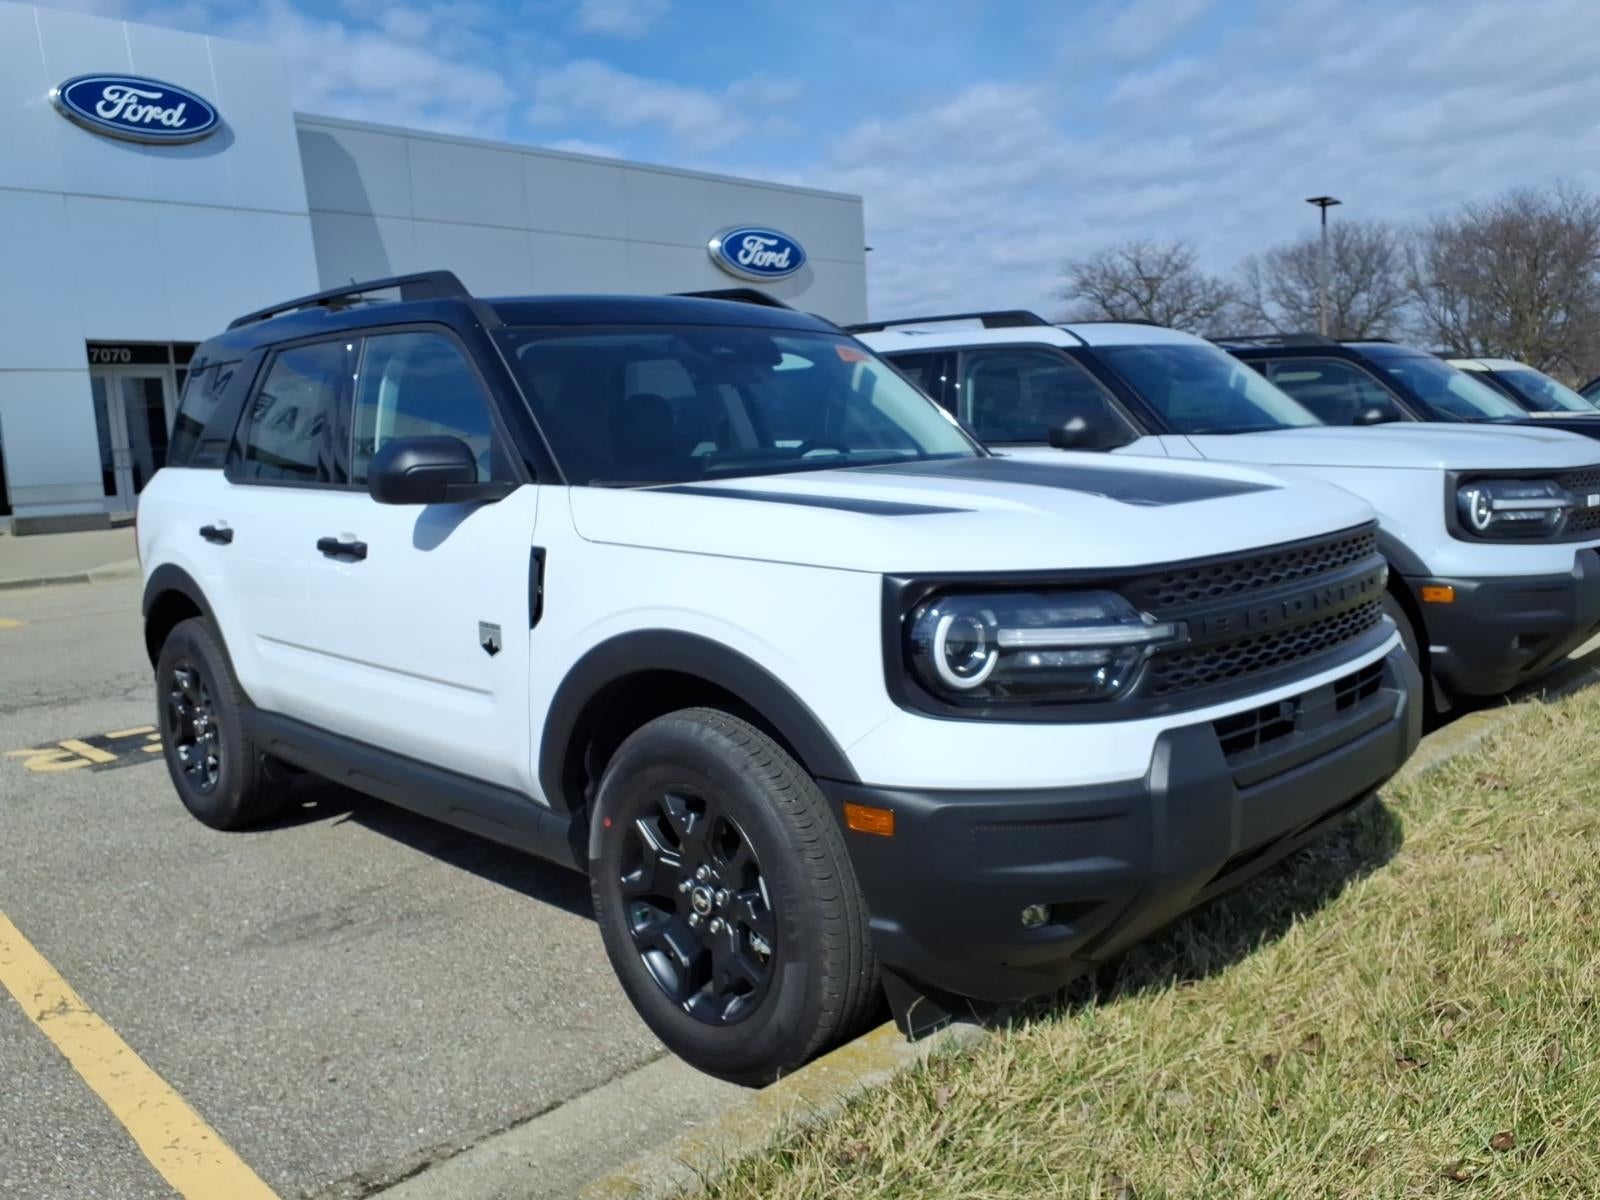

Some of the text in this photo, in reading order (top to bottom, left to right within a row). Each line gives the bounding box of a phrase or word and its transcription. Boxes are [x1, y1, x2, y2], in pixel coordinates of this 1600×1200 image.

[96, 85, 187, 128] Ford
[737, 235, 791, 268] Ford
[89, 347, 132, 363] 7070
